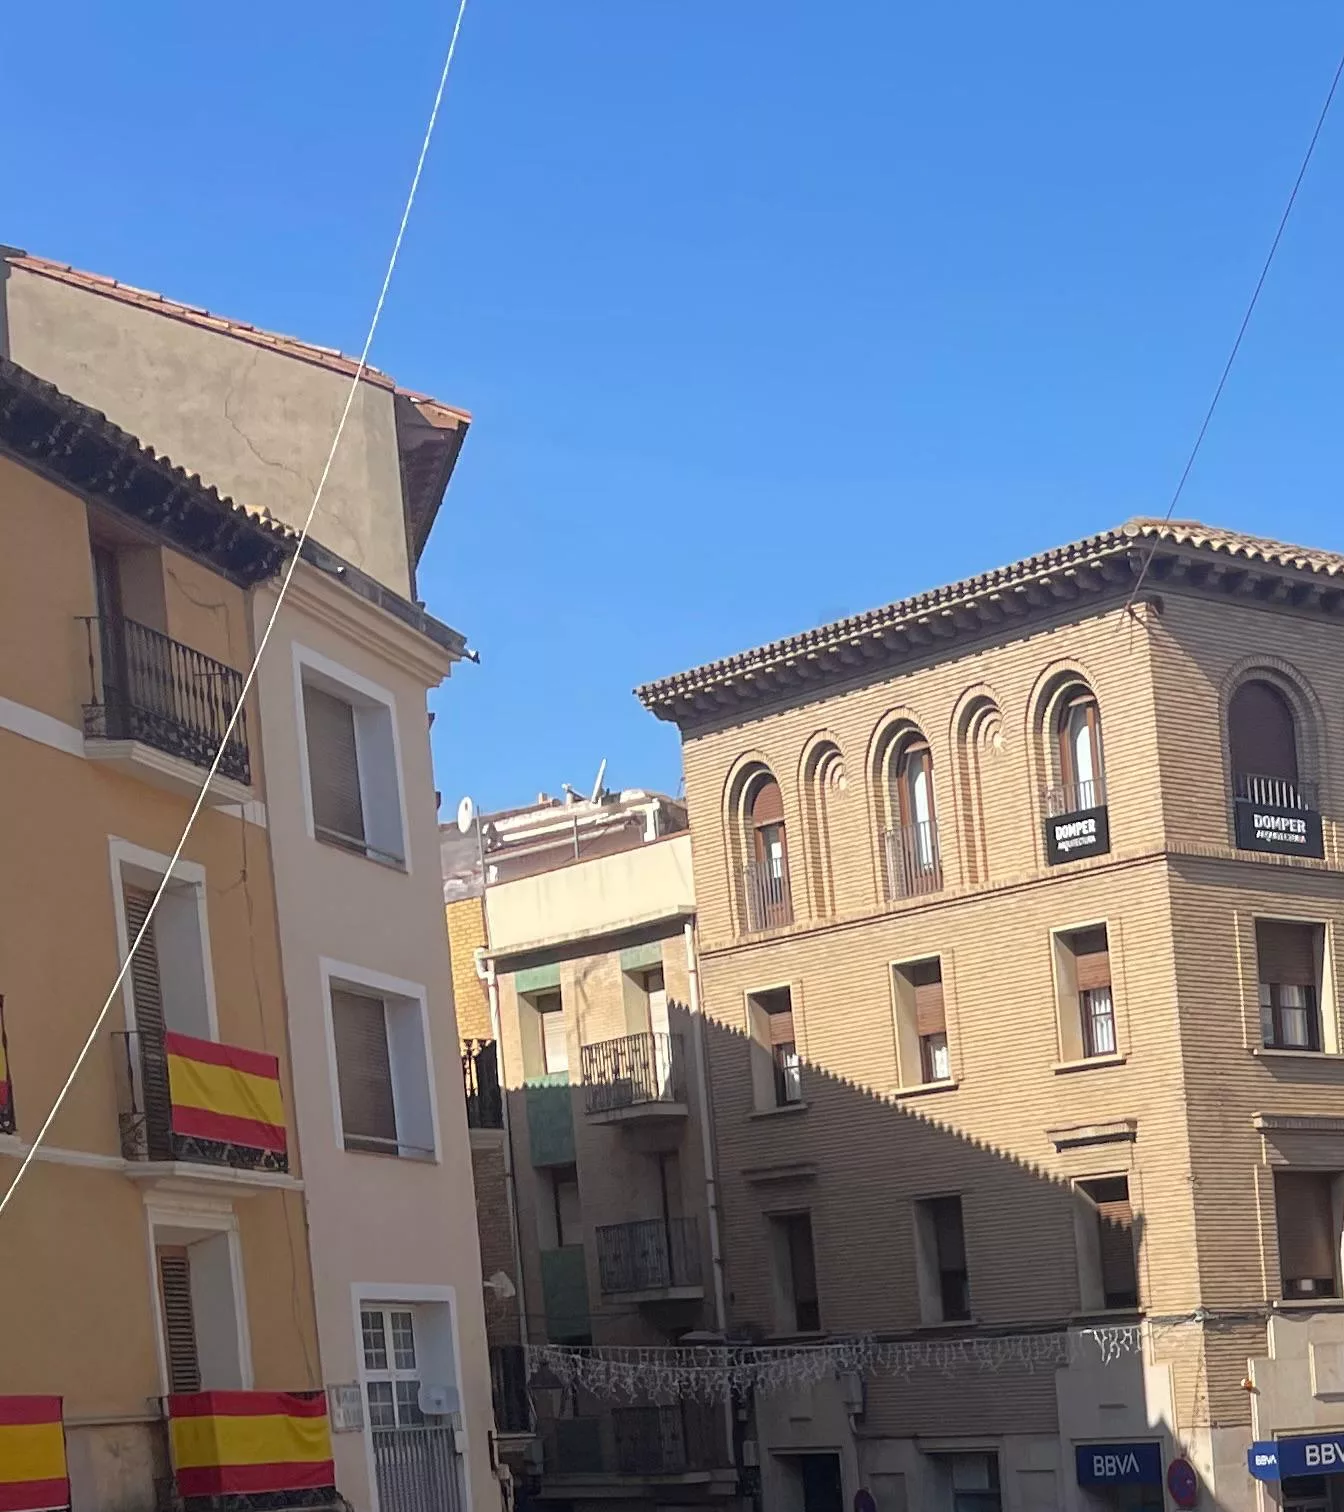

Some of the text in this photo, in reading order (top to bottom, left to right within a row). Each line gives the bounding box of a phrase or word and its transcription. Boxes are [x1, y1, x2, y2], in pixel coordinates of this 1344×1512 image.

[1055, 819, 1096, 840] DOMPER
[1253, 814, 1306, 833] DOMPER
[1093, 1453, 1139, 1476] BBVA
[1255, 1455, 1277, 1466] BBVA
